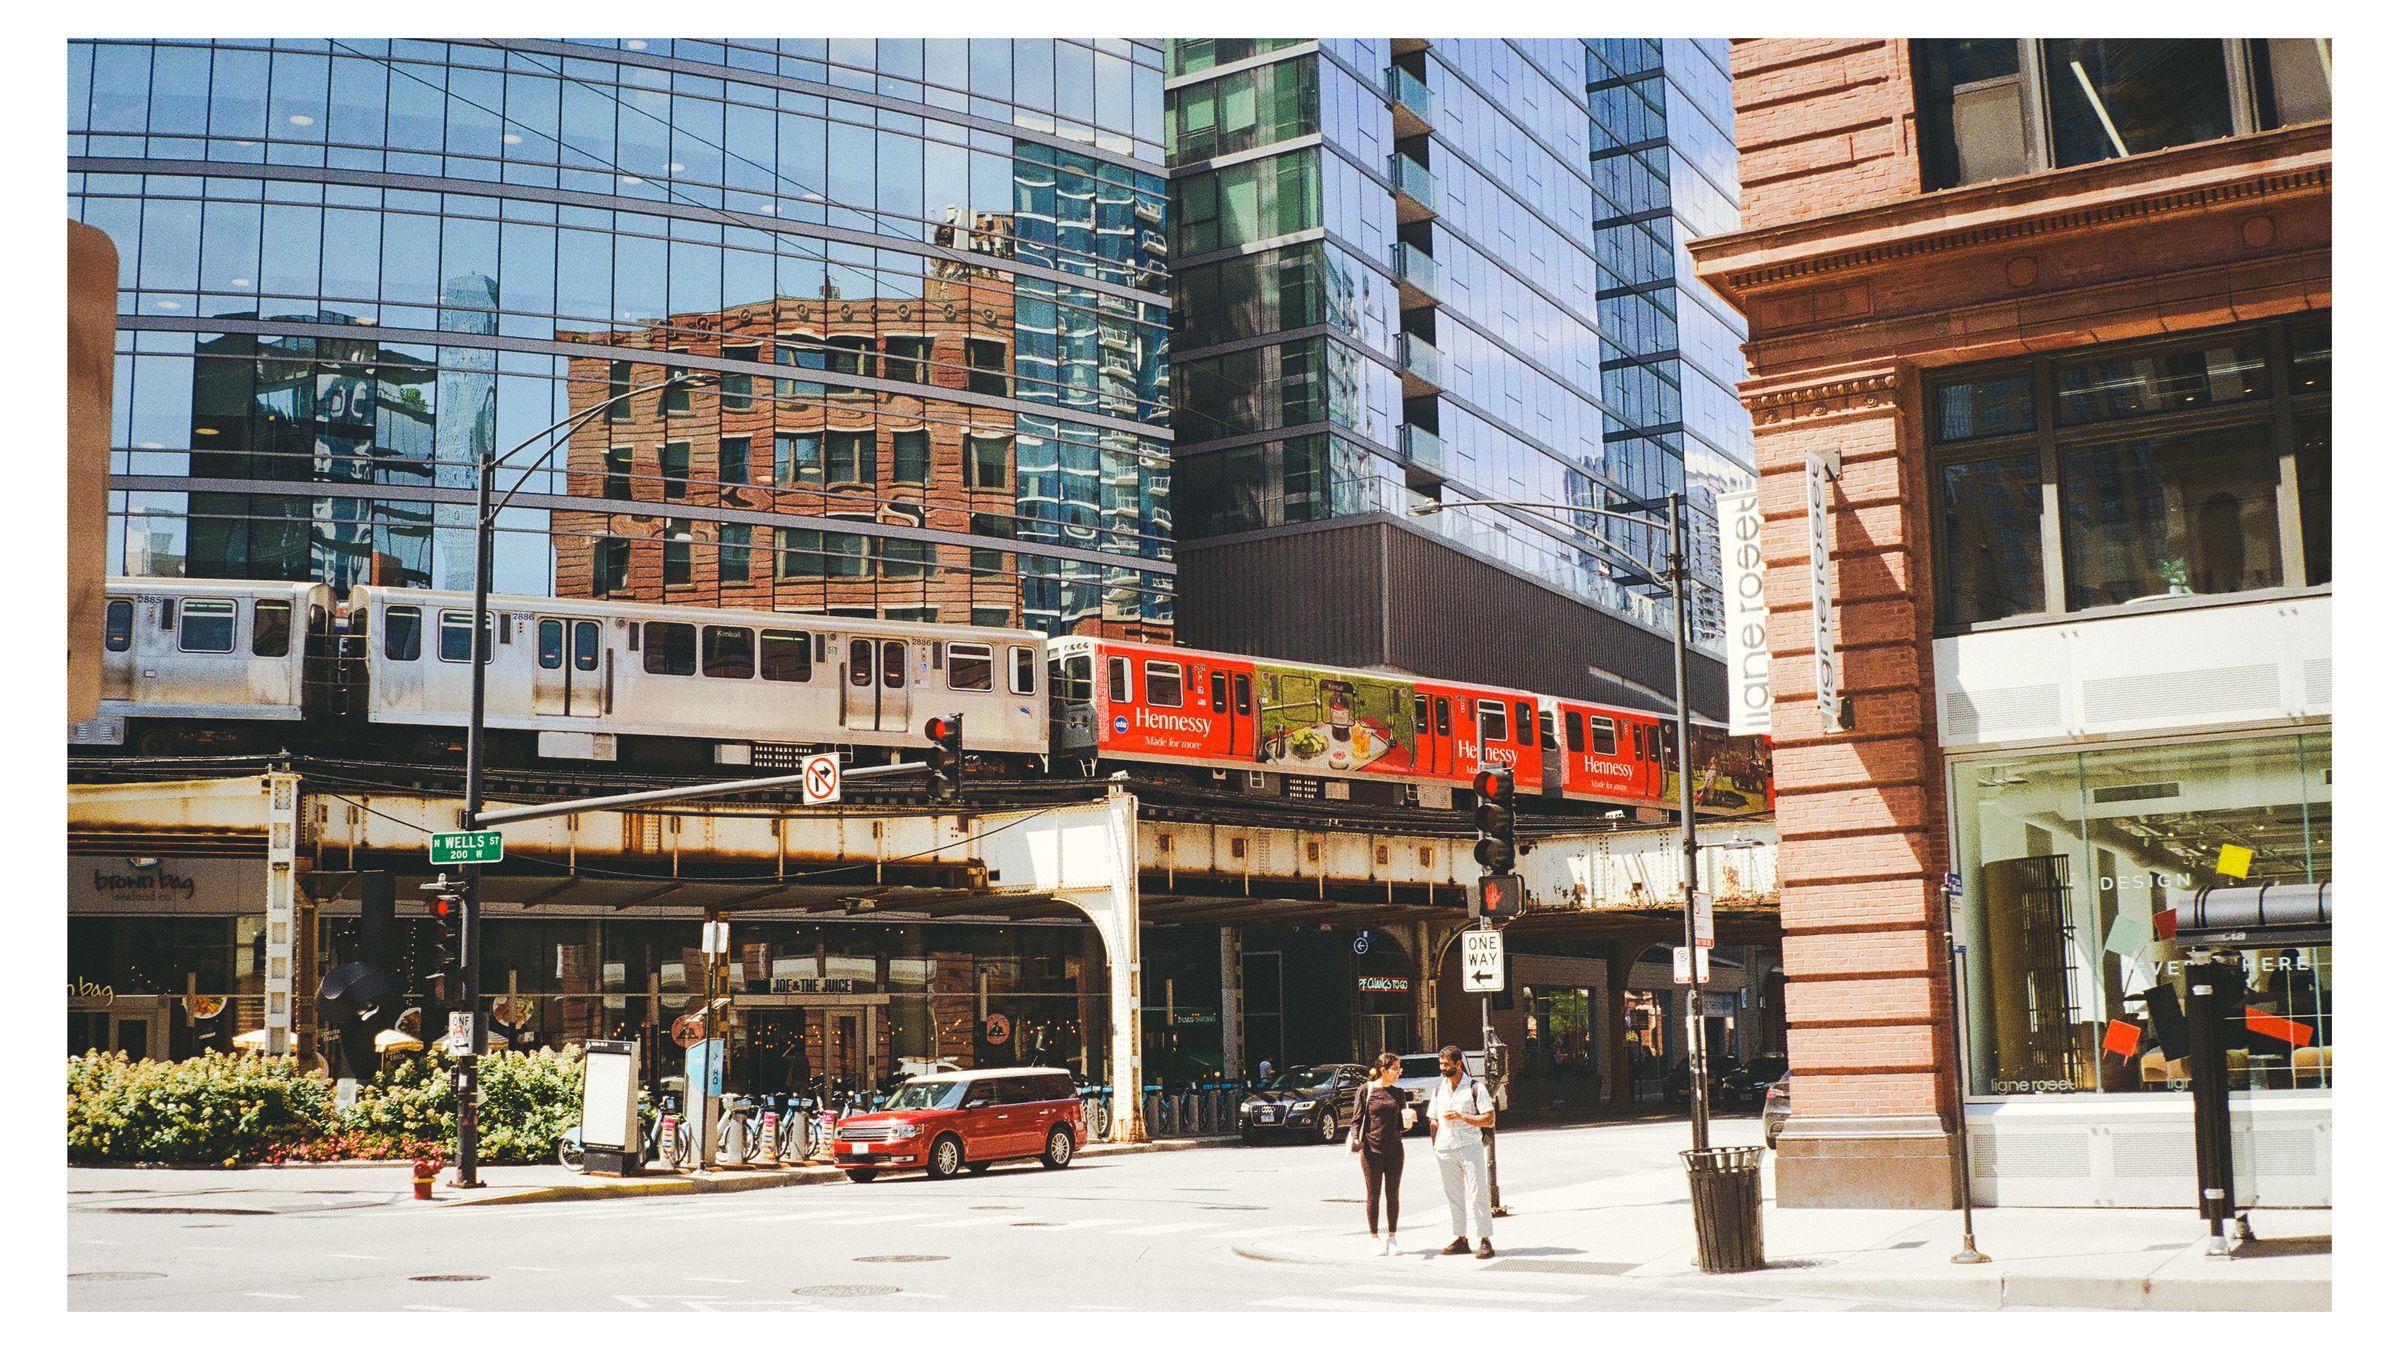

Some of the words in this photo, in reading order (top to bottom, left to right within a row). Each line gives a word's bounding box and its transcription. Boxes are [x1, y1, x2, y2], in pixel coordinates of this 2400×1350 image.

[137, 595, 162, 604] 2885
[512, 612, 535, 621] 2886
[716, 630, 741, 638] Kimball
[911, 638, 932, 646] 2886
[1135, 706, 1213, 738] Hennessy
[1145, 735, 1168, 747] Made
[1168, 737, 1180, 748] for
[1181, 740, 1203, 750] more
[1458, 739, 1519, 767] Henessy
[1584, 754, 1634, 781] Hennessy
[434, 839, 440, 848] N
[445, 835, 485, 849] WELLS
[489, 836, 500, 846] ST
[450, 850, 468, 860] 200
[475, 850, 483, 859] W
[94, 869, 154, 892] brown
[158, 867, 194, 900] bag
[2100, 872, 2191, 891] DESIGN
[1468, 936, 1497, 950] ONE
[1468, 952, 1498, 967] WAY
[79, 975, 114, 1007] bag
[821, 978, 852, 993] JUICE
[1990, 1078, 2030, 1095] ligne
[2031, 1078, 2076, 1092] roset
